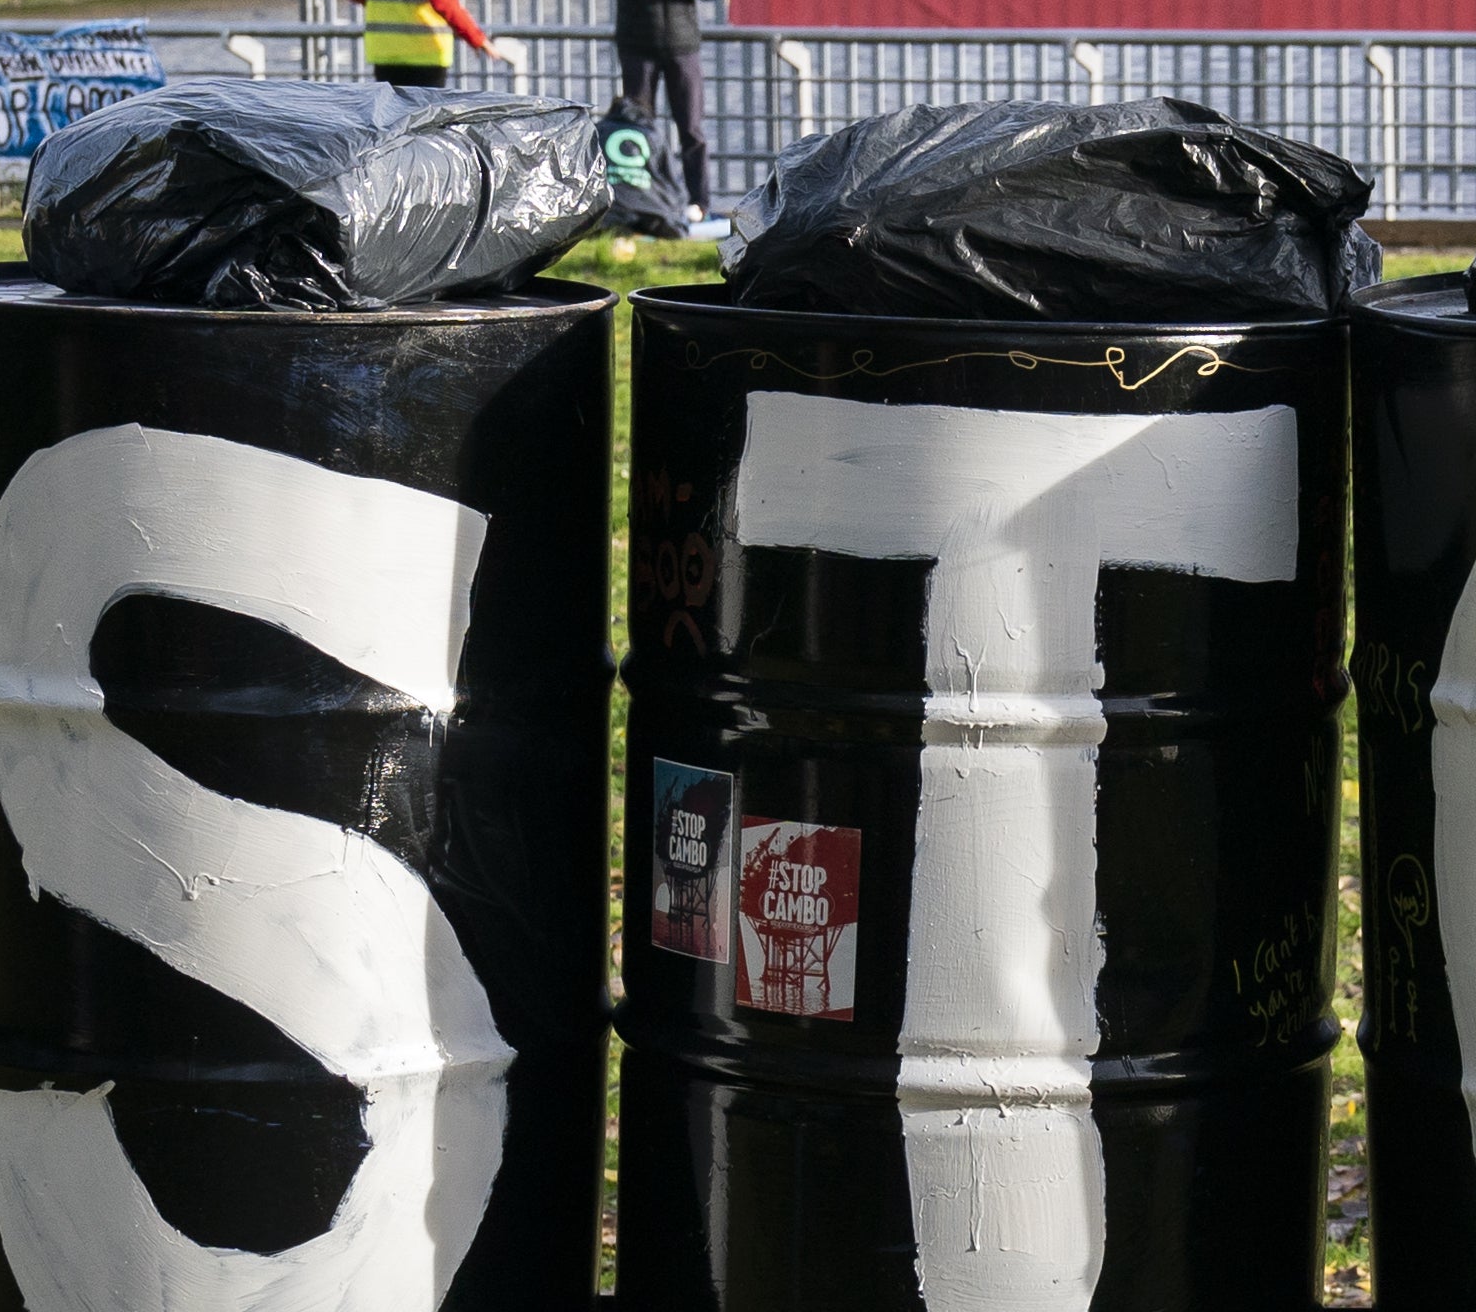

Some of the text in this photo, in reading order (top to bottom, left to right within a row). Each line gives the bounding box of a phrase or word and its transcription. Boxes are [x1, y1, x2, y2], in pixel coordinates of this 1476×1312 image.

[671, 809, 706, 841] #STOP
[669, 835, 708, 868] CAMBO
[768, 860, 827, 895] #STOP
[763, 890, 829, 926] CAMBO
